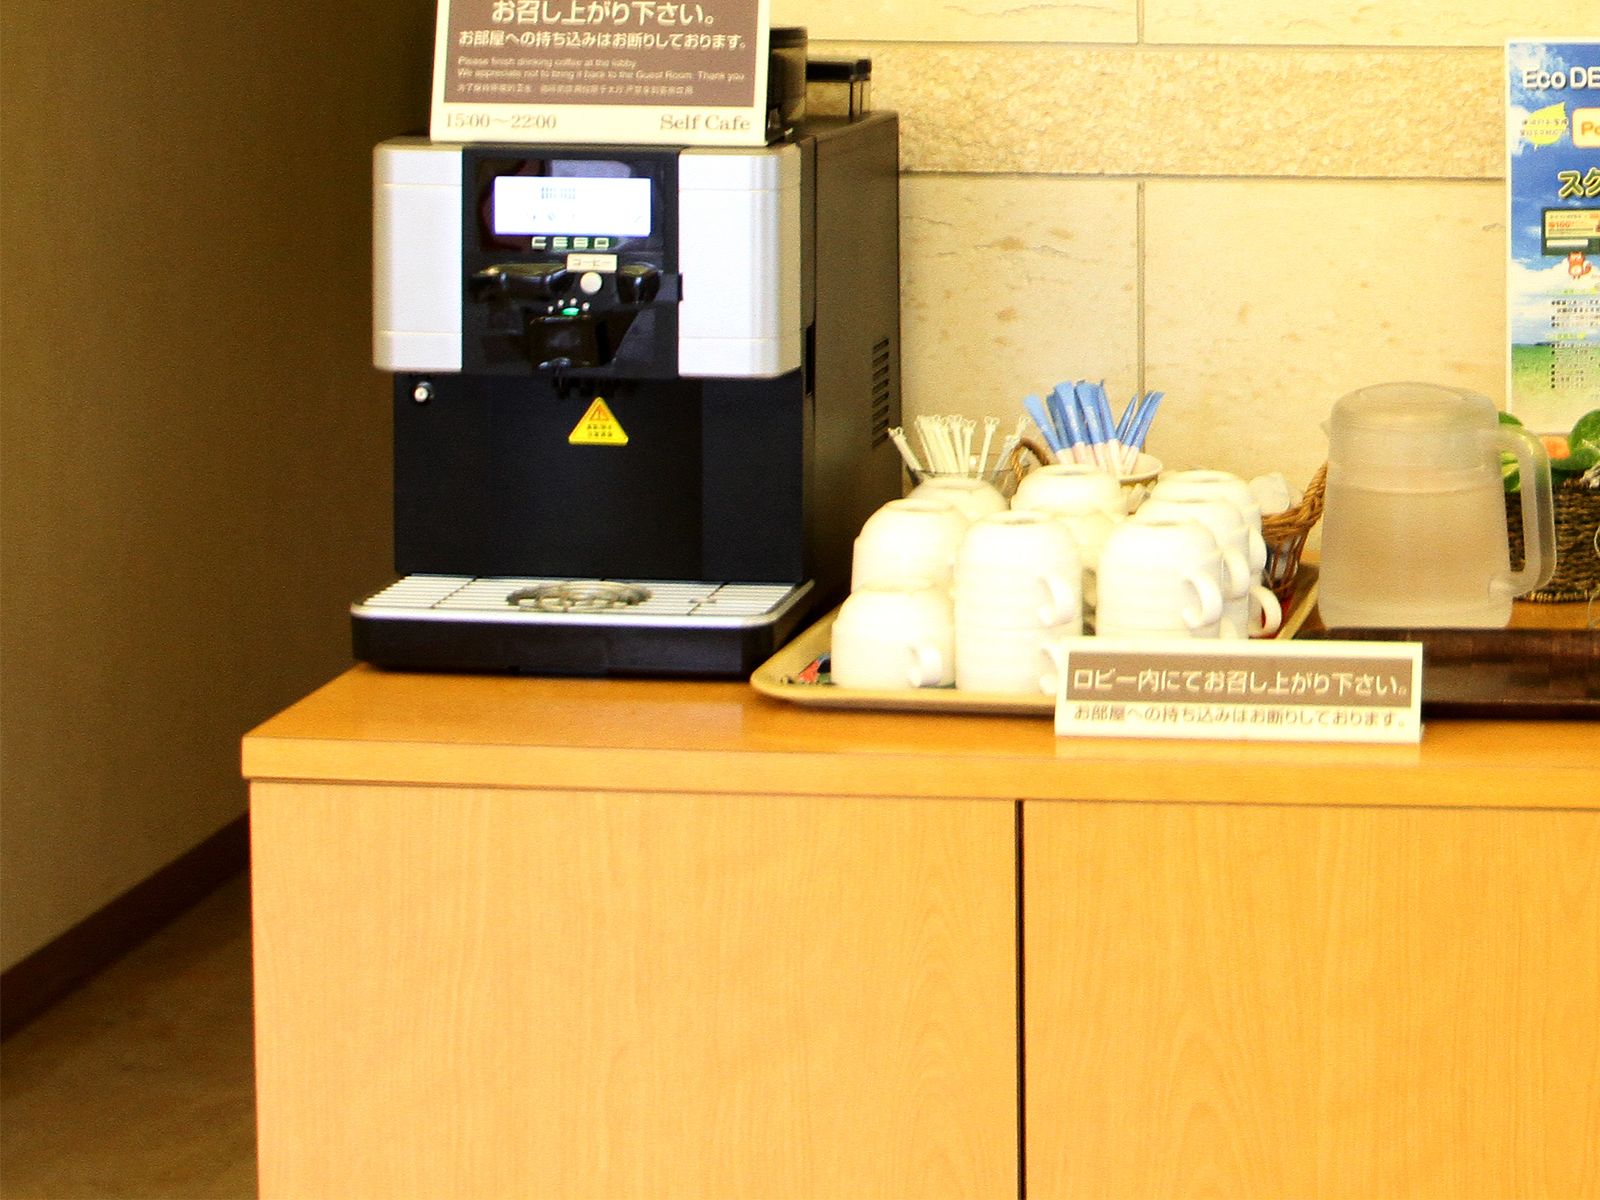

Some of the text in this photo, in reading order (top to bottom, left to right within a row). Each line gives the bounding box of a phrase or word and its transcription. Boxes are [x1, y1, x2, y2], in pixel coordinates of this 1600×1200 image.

[491, 0, 715, 26] お召し上がり下さい。
[458, 30, 747, 50] お部屋への持ち込みはお断りしております。
[1522, 67, 1566, 90] Eco
[660, 114, 699, 131] Self
[705, 114, 751, 131] Cafe
[1074, 667, 1408, 697] ロビー内にてお召し上がり下さい。
